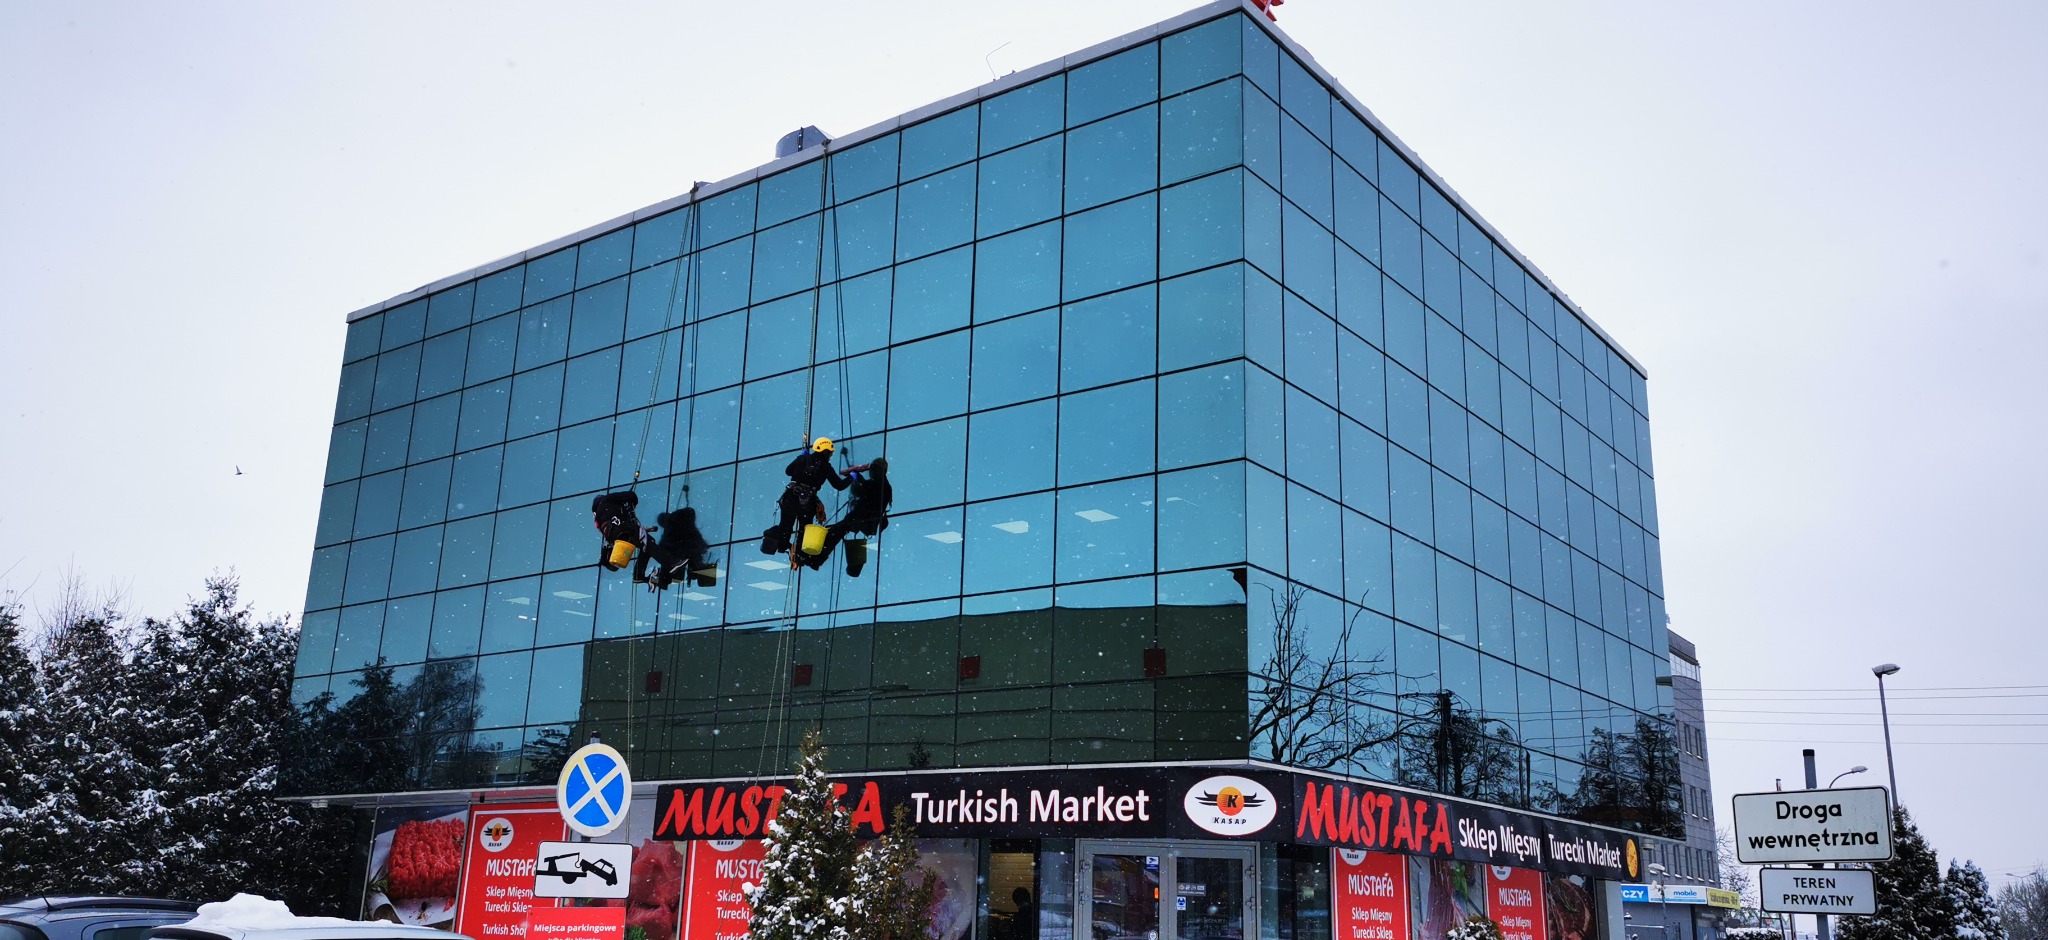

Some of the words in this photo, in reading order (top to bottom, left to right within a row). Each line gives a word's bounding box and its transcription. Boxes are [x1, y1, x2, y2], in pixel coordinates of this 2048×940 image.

[1227, 794, 1239, 808] K
[656, 781, 885, 836] MUSTA
[911, 788, 1018, 823] Turkish
[1029, 786, 1150, 822] Market
[1776, 801, 1842, 823] Droga
[1213, 817, 1247, 825] KASAP
[1296, 781, 1453, 855] MUSTAFA
[1458, 818, 1498, 857] Sklep
[1500, 825, 1541, 864] Mięsny
[1748, 828, 1879, 852] wewnętrzna
[1548, 834, 1585, 863] Turecki
[1586, 840, 1622, 869] Market
[715, 859, 765, 879] MUSTA
[1348, 873, 1394, 898] MUSTAFA
[1793, 877, 1836, 889] TEREN
[486, 886, 506, 899] Sklep
[717, 890, 742, 905] Sklep
[1498, 887, 1532, 907] MUSTAFA
[1621, 890, 1644, 899] CZY
[485, 901, 511, 913] Turecki
[1783, 894, 1854, 907] PRYWATNY
[716, 907, 750, 920] Turecki
[1351, 907, 1370, 923] Sklep
[1370, 908, 1392, 924] Mięsny
[483, 924, 509, 935] Turkish
[533, 924, 565, 933] Miejsca
[567, 924, 617, 933] parkingowe
[1352, 926, 1376, 938] Turecki
[1376, 928, 1394, 940] Sklep
